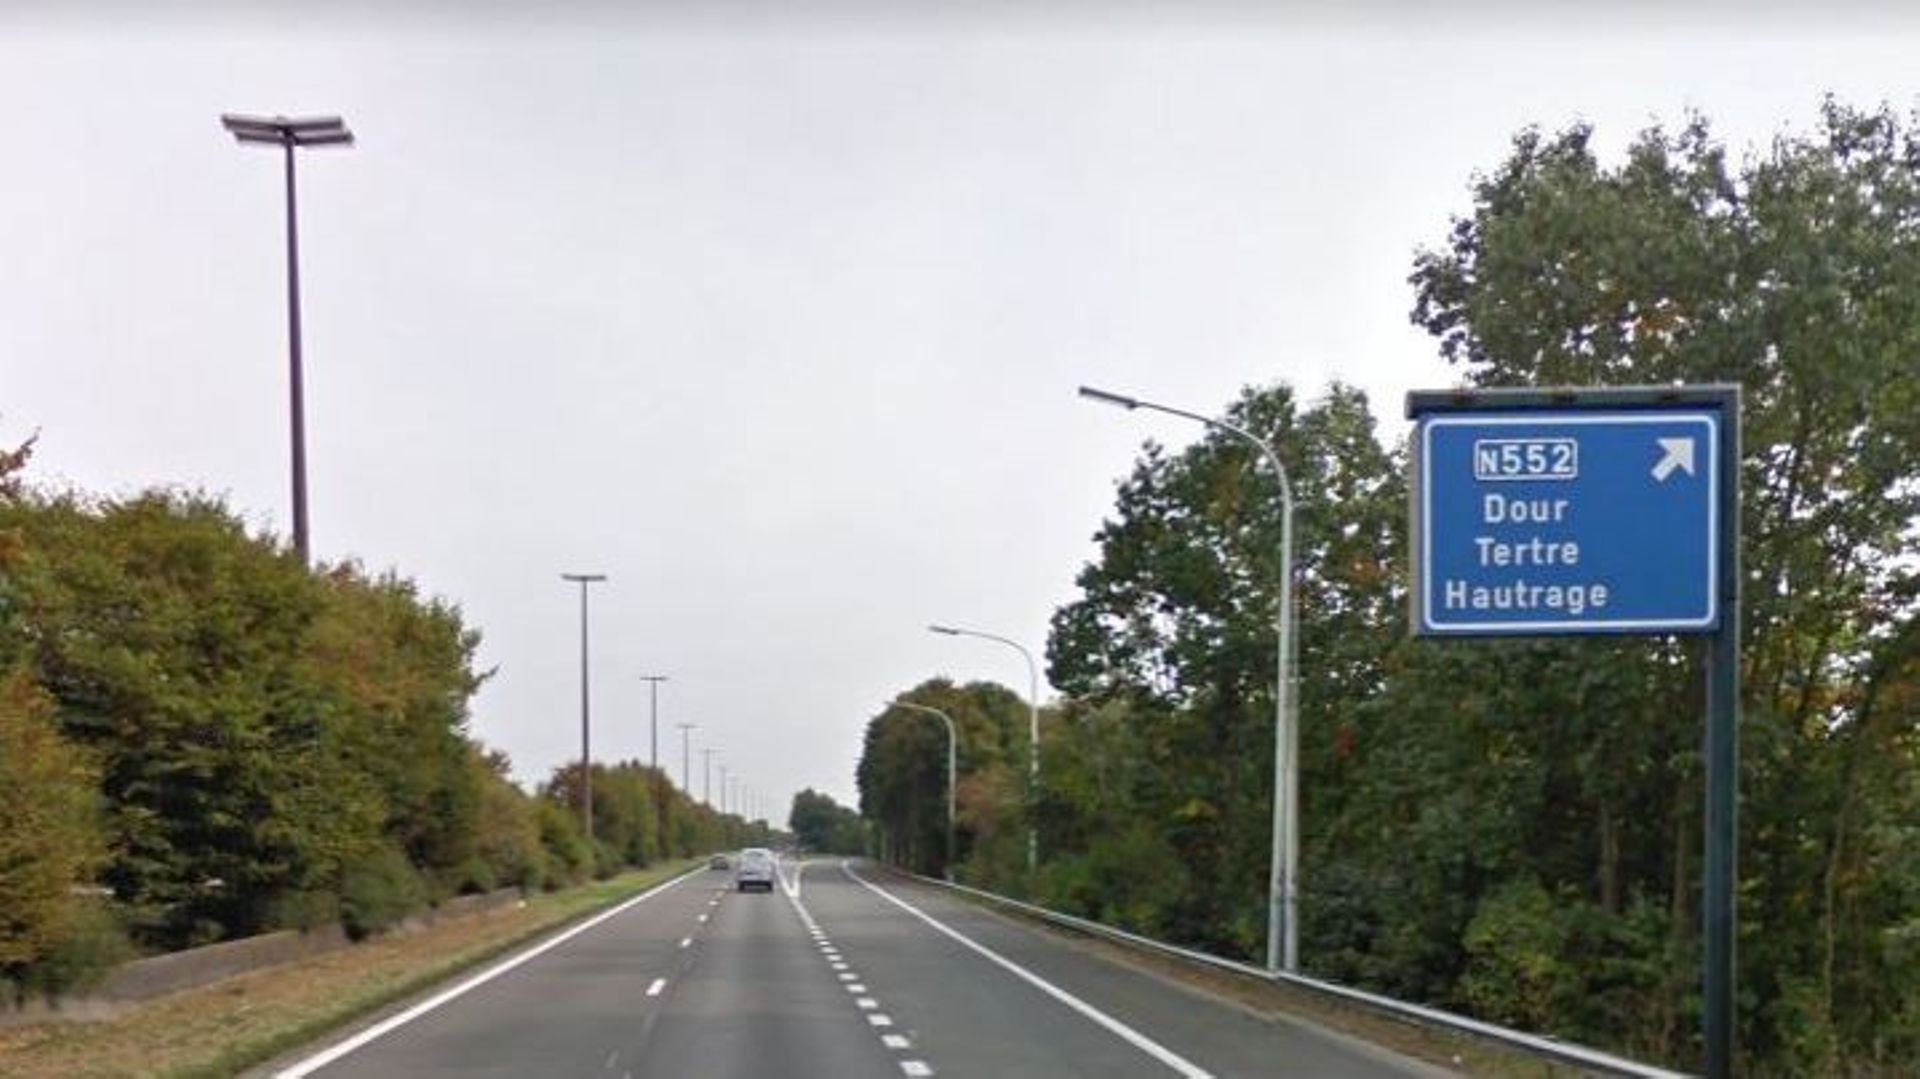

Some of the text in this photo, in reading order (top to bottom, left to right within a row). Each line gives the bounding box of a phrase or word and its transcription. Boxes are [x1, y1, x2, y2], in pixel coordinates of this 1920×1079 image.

[1479, 445, 1573, 474] N552
[1484, 494, 1567, 523] Dour
[1475, 537, 1579, 565] Tertre
[1445, 581, 1607, 614] Hautrage
